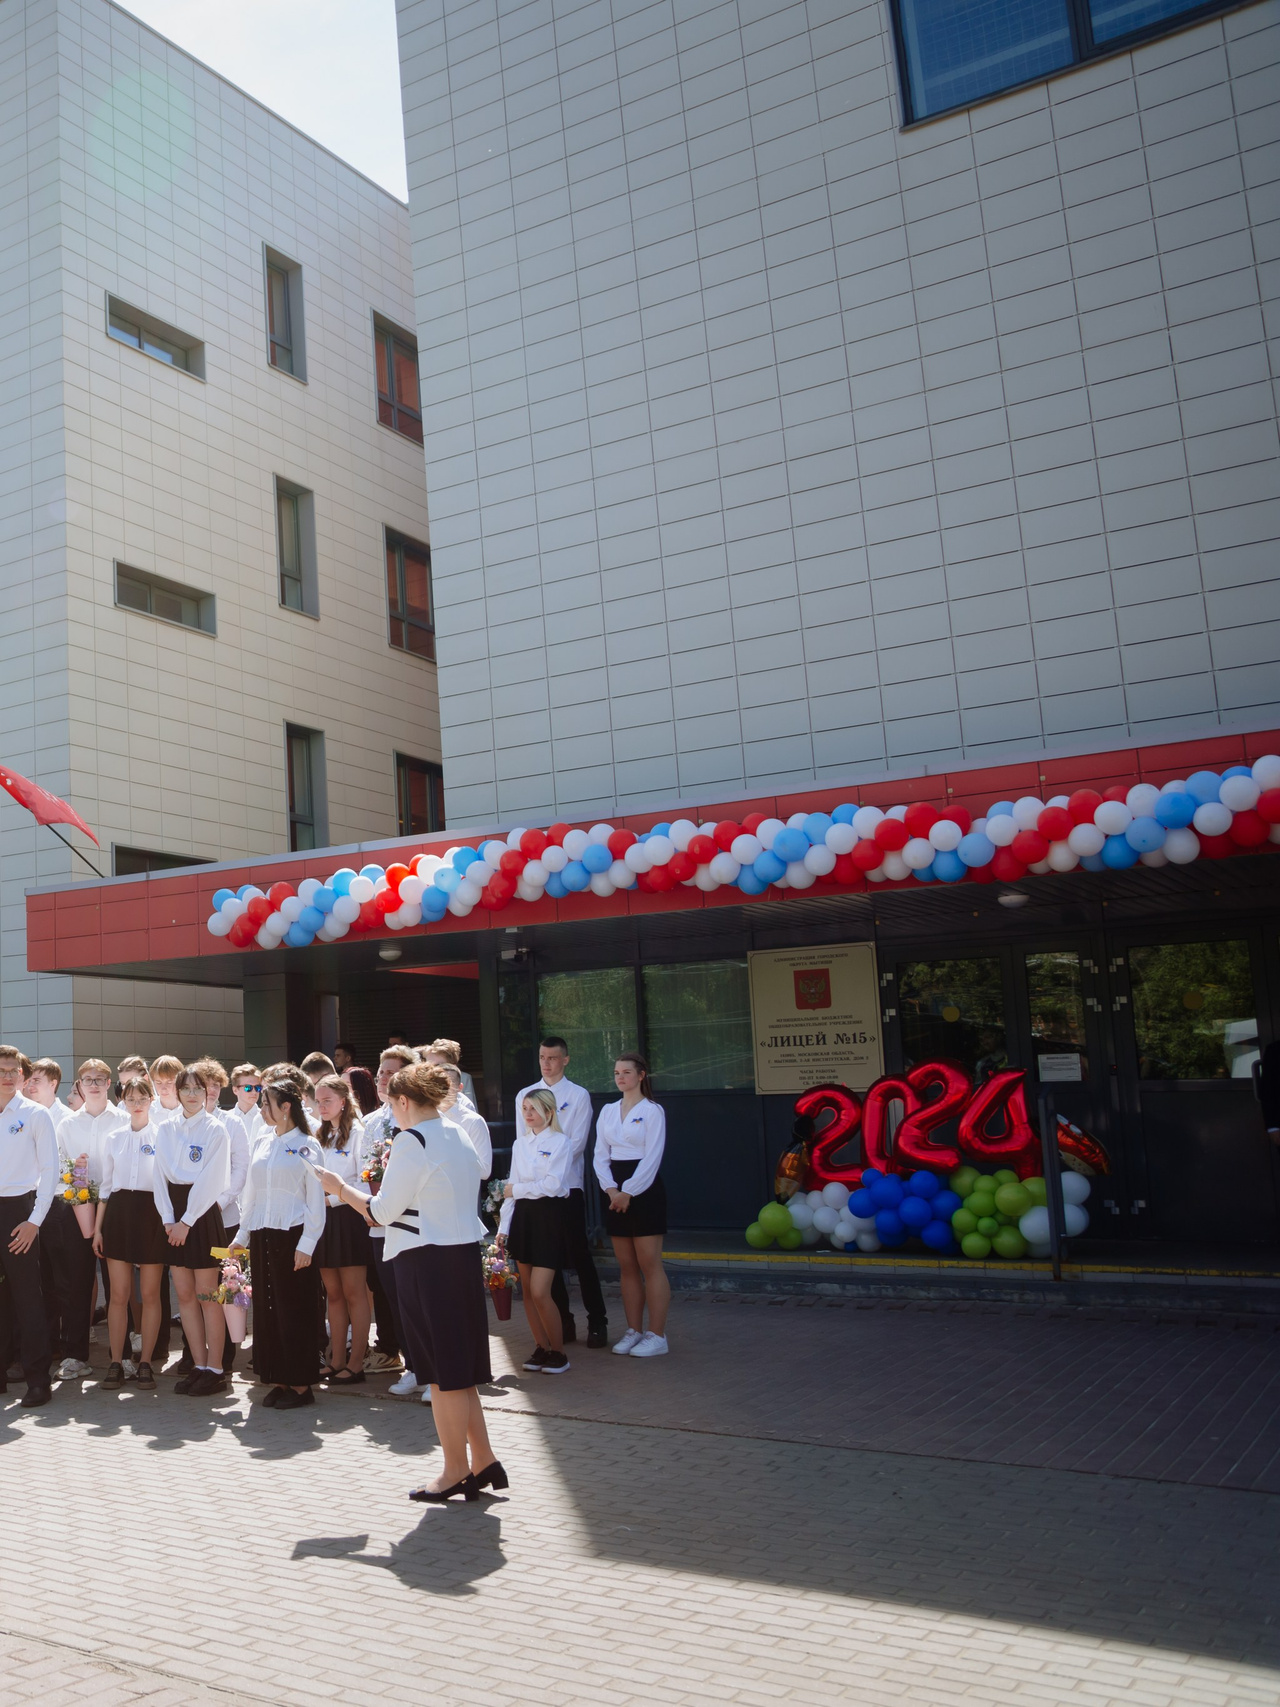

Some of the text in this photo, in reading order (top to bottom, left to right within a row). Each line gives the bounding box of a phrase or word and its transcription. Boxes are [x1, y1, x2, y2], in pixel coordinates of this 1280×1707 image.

[760, 1031, 877, 1048] «ЛИЦЕЙ №15»
[794, 1057, 1042, 1190] 2024
